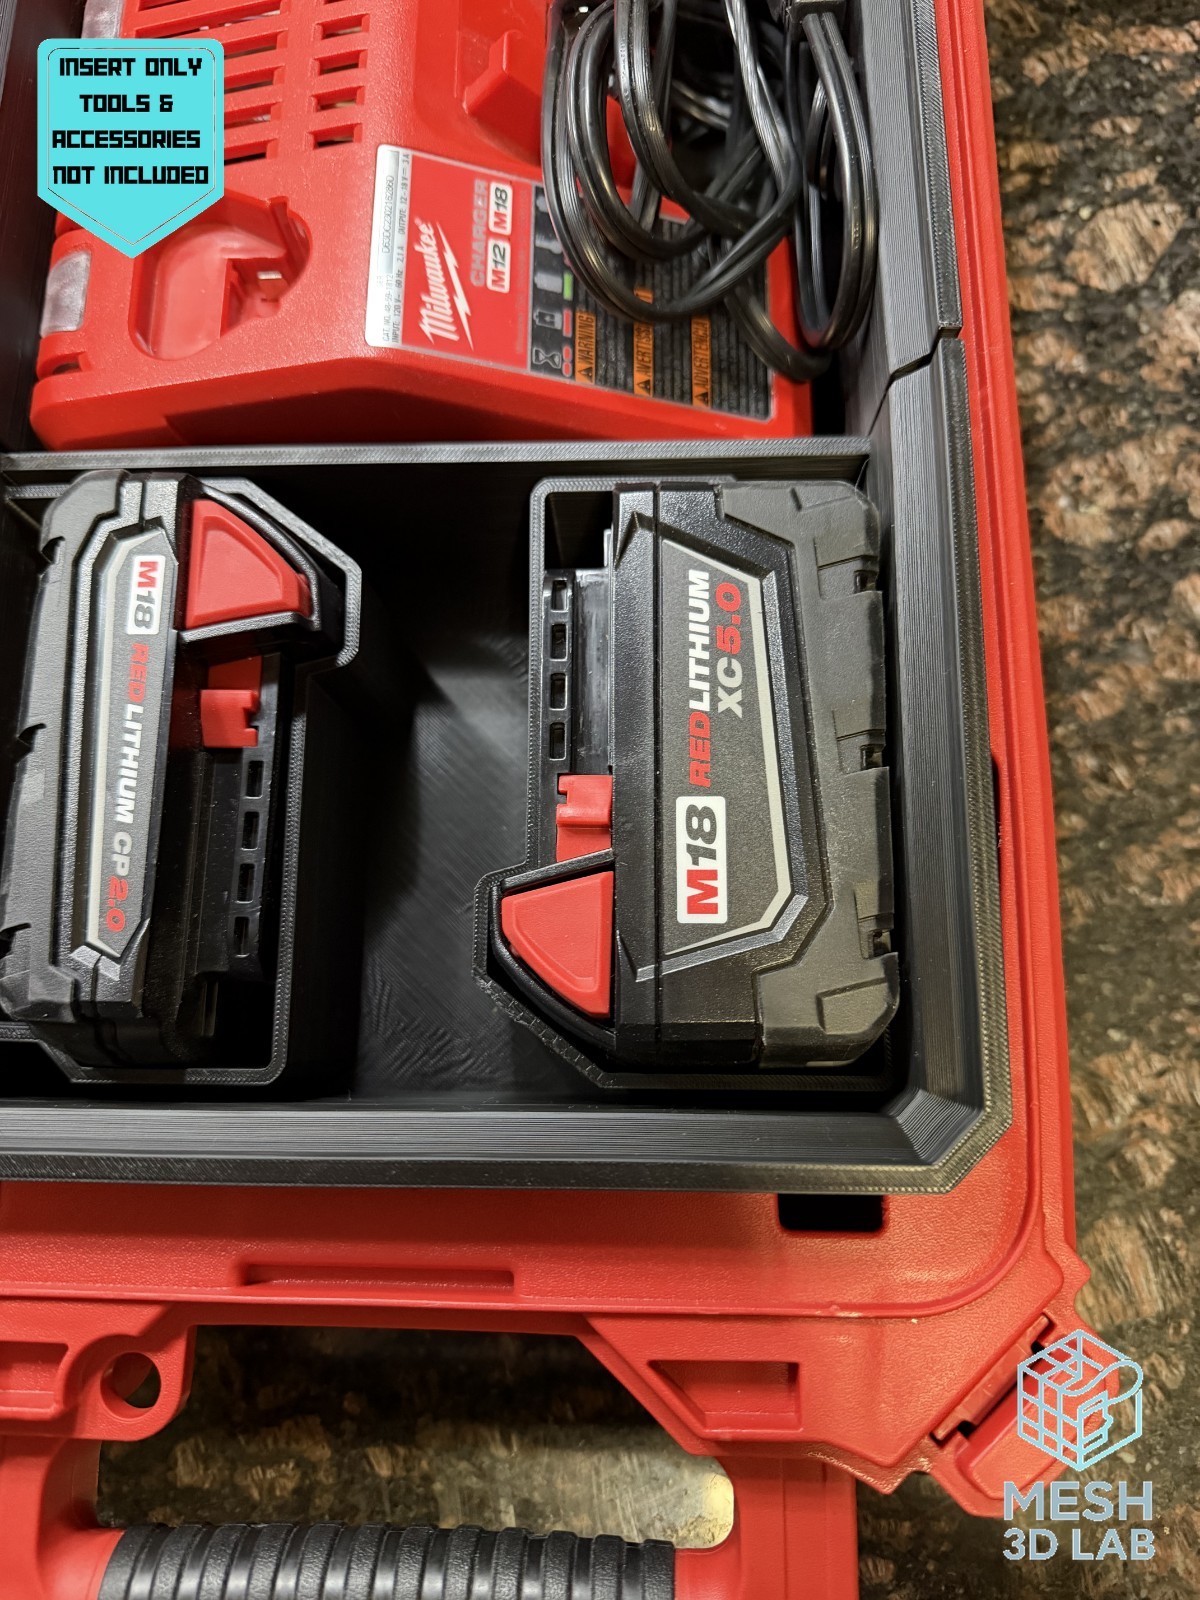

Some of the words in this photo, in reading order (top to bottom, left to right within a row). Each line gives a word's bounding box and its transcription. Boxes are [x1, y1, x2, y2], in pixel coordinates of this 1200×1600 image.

[470, 179, 488, 287] CHARGER
[493, 186, 509, 230] M18
[491, 244, 507, 290] M12
[577, 315, 594, 364] WARNING
[693, 318, 711, 390] ADVERTENCIA
[134, 561, 159, 630] M18
[688, 569, 711, 788] REDLITHIUM
[715, 582, 743, 719] XC5.0
[114, 642, 149, 824] REDLITHIUM
[686, 804, 718, 914] M18
